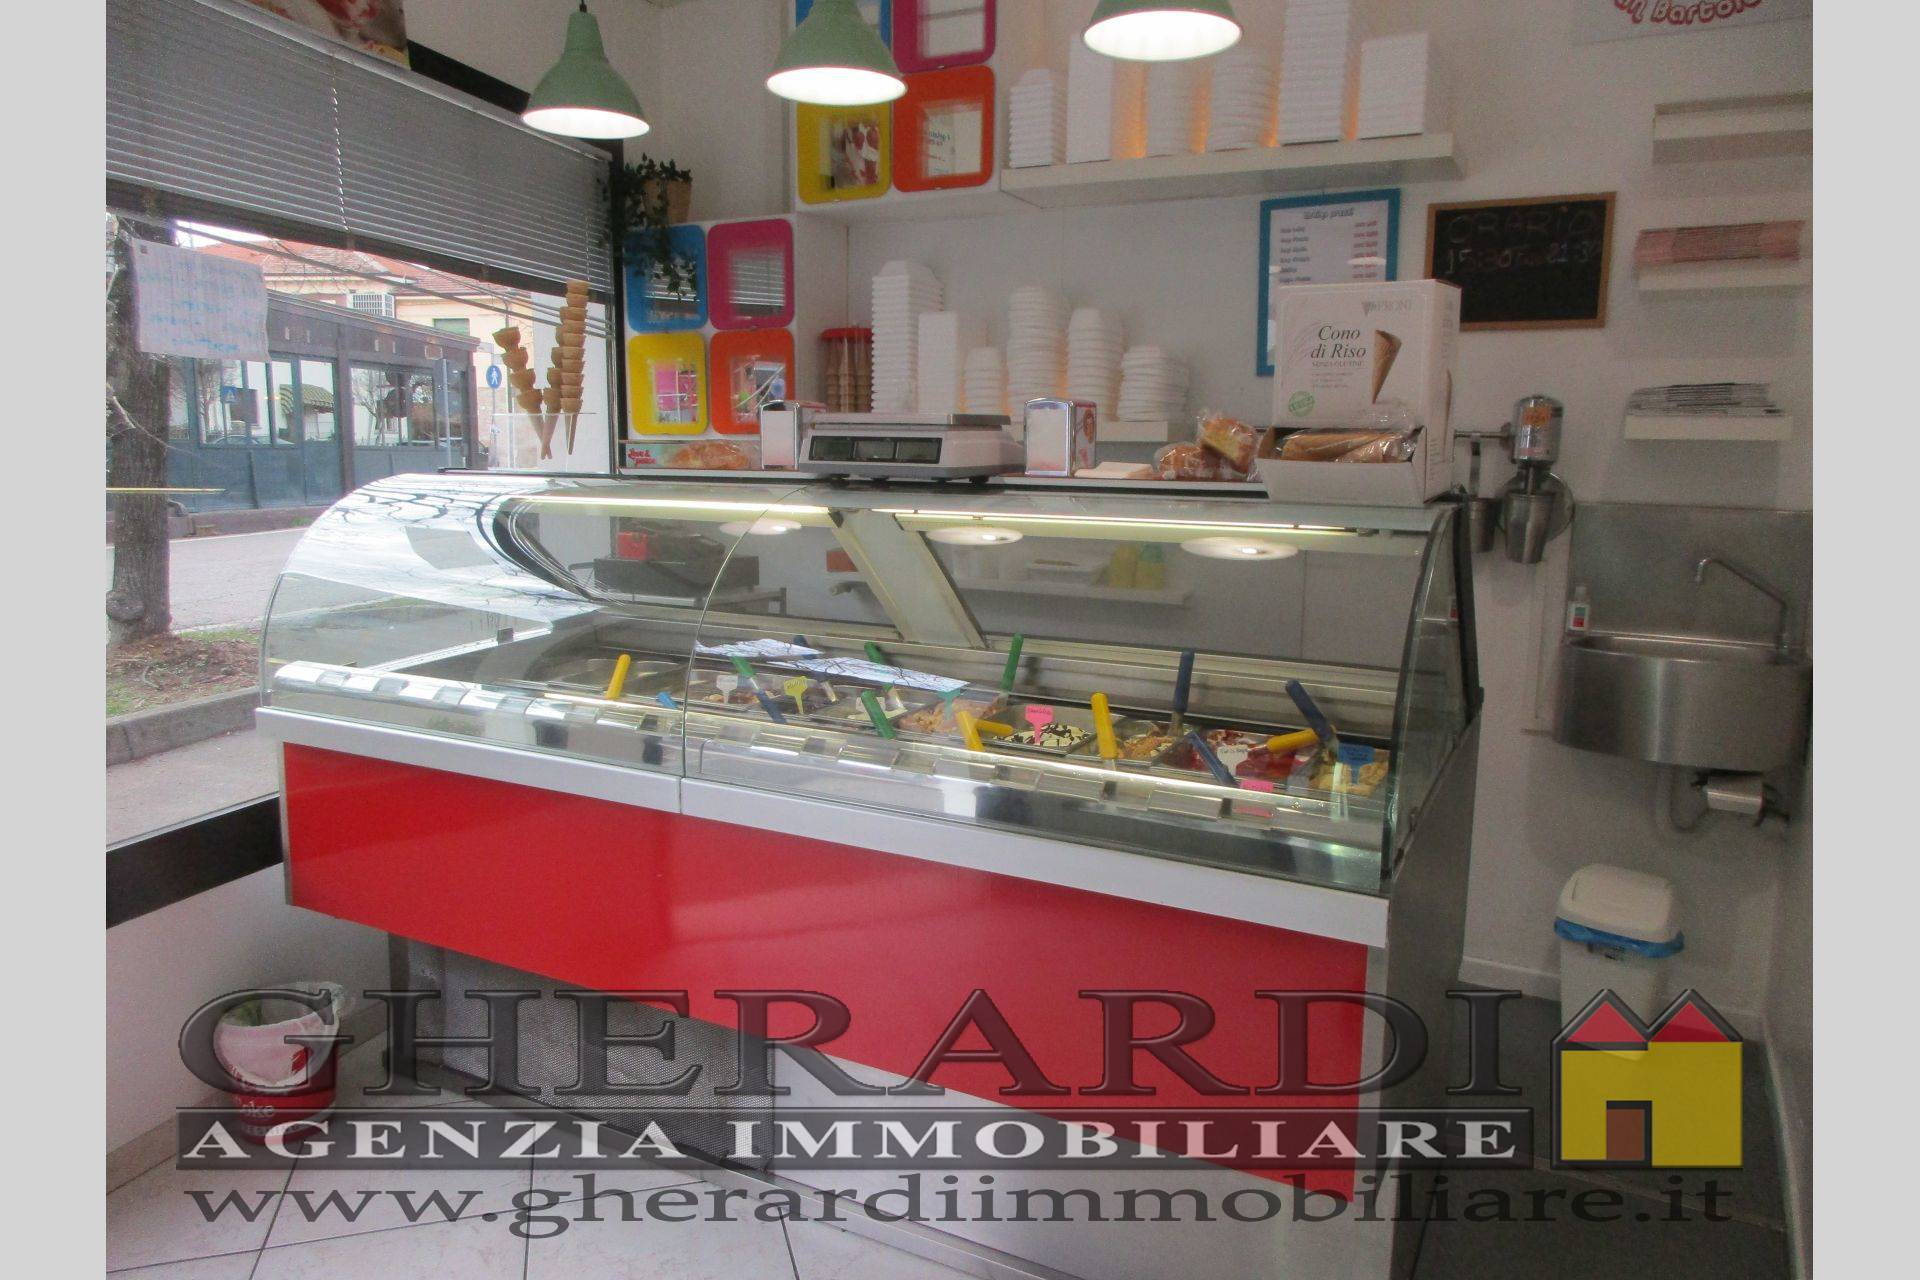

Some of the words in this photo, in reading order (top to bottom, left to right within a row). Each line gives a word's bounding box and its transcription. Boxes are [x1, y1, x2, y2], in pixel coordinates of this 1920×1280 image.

[1318, 325, 1361, 341] Cono
[1310, 343, 1326, 359] di
[1331, 343, 1366, 359] Riso
